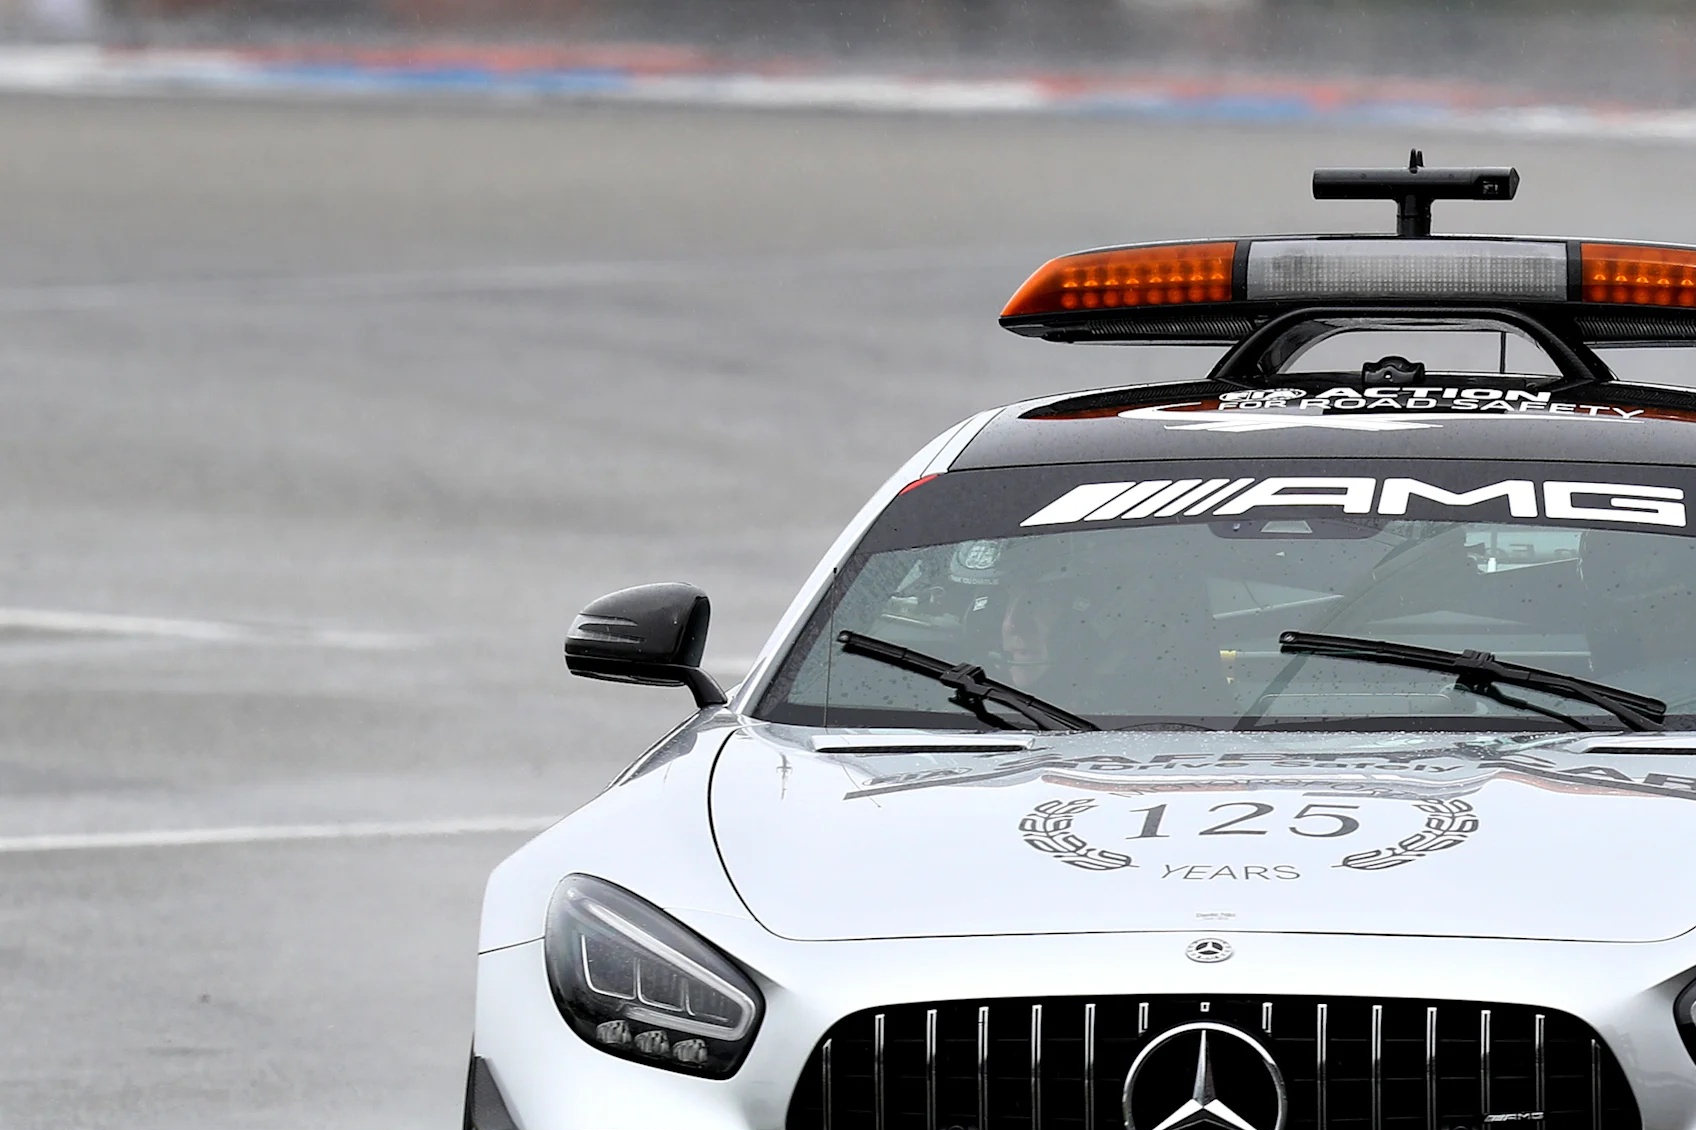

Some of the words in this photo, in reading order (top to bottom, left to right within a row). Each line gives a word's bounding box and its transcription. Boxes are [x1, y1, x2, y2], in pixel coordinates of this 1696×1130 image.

[1314, 387, 1551, 401] ACTION
[1218, 400, 1287, 410] FOR
[1299, 398, 1439, 410] ROAD
[1450, 398, 1645, 419] SAFETY
[1212, 477, 1687, 527] AMG
[1089, 762, 1249, 771] Drive
[1269, 760, 1465, 773] Safely
[1125, 802, 1360, 839] 125
[1161, 864, 1301, 880] YEARS
